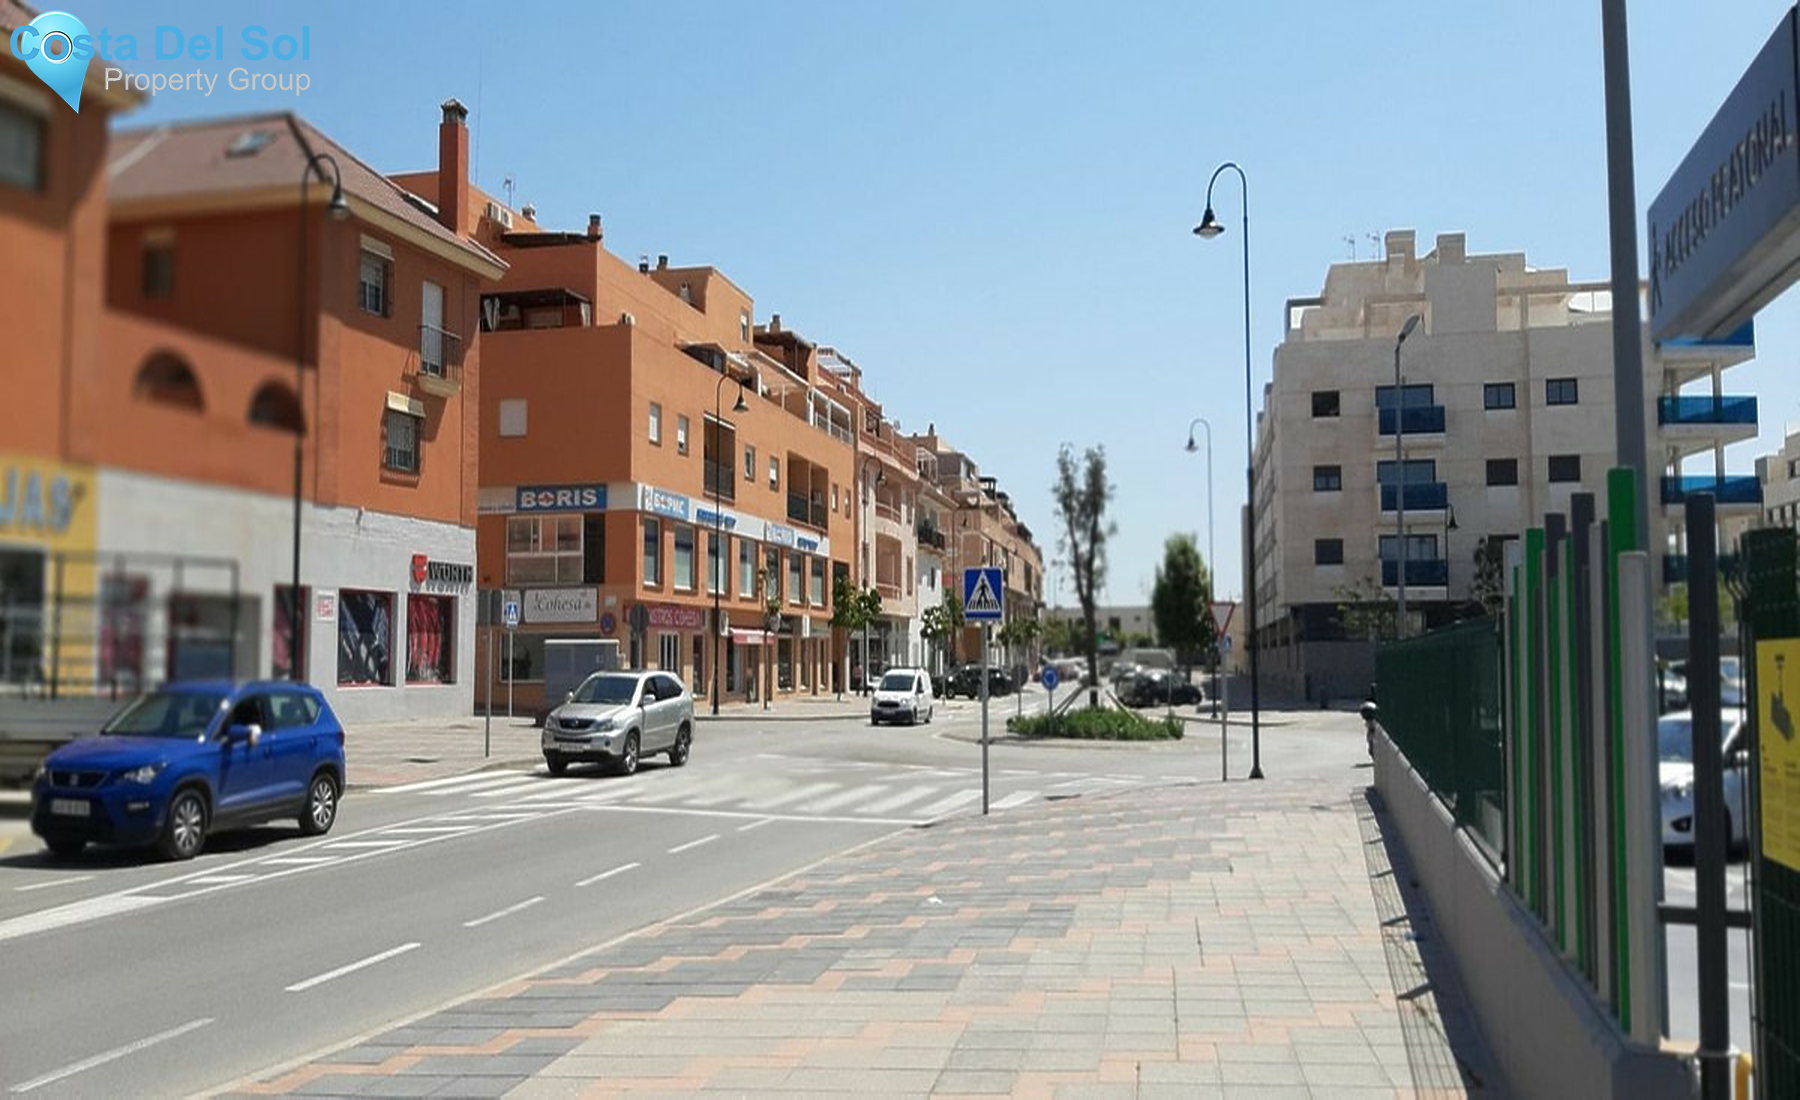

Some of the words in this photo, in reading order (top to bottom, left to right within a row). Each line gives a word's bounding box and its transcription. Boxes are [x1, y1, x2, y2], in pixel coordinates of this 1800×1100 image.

[1665, 187, 1709, 279] ACCESO
[1711, 90, 1792, 227] PEATONAL
[520, 488, 598, 508] BORIS
